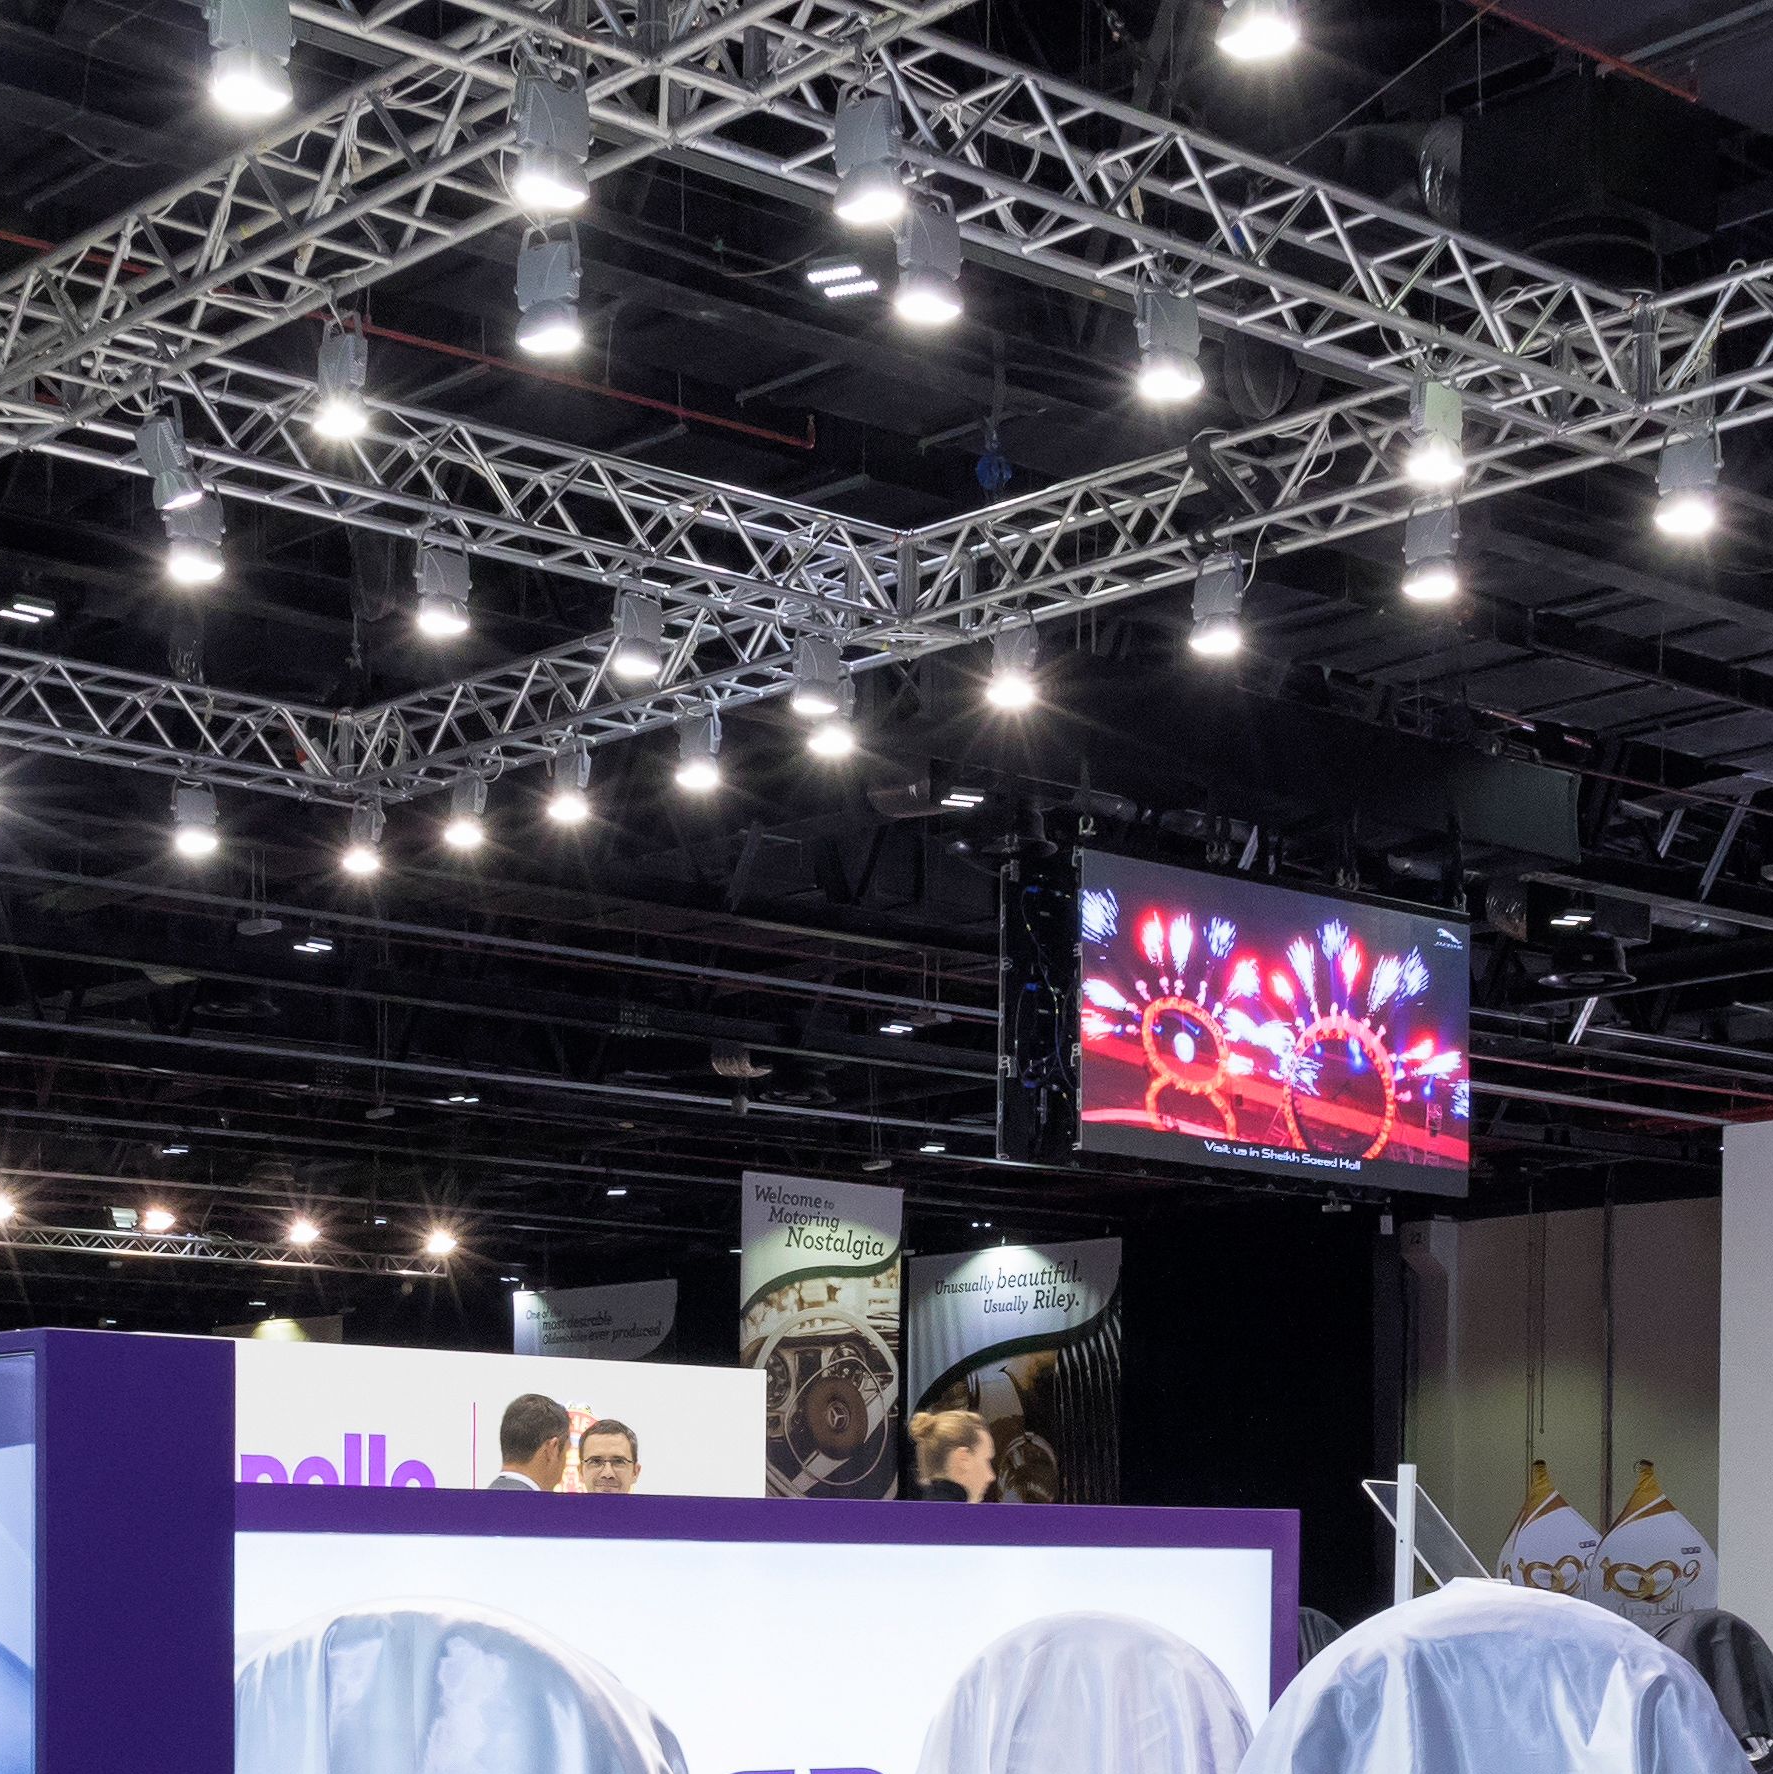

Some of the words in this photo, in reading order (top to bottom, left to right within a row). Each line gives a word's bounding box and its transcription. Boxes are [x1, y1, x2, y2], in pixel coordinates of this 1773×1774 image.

[1204, 1140, 1231, 1154] Visit
[1233, 1147, 1247, 1156] us
[1249, 1147, 1259, 1157] in
[1262, 1148, 1300, 1163] Sheikh
[1302, 1154, 1338, 1168] Saeed
[1340, 1157, 1361, 1171] Hall
[754, 1184, 824, 1209] Welcome
[824, 1200, 835, 1210] to
[768, 1206, 841, 1233] Motoring
[785, 1226, 885, 1260] Nostalgia
[934, 1276, 994, 1295] Unusually
[997, 1260, 1082, 1289] beautiful.
[983, 1296, 1028, 1314] Usually
[1033, 1286, 1080, 1312] Riley.
[542, 1318, 567, 1330] most
[611, 1320, 662, 1343] produced
